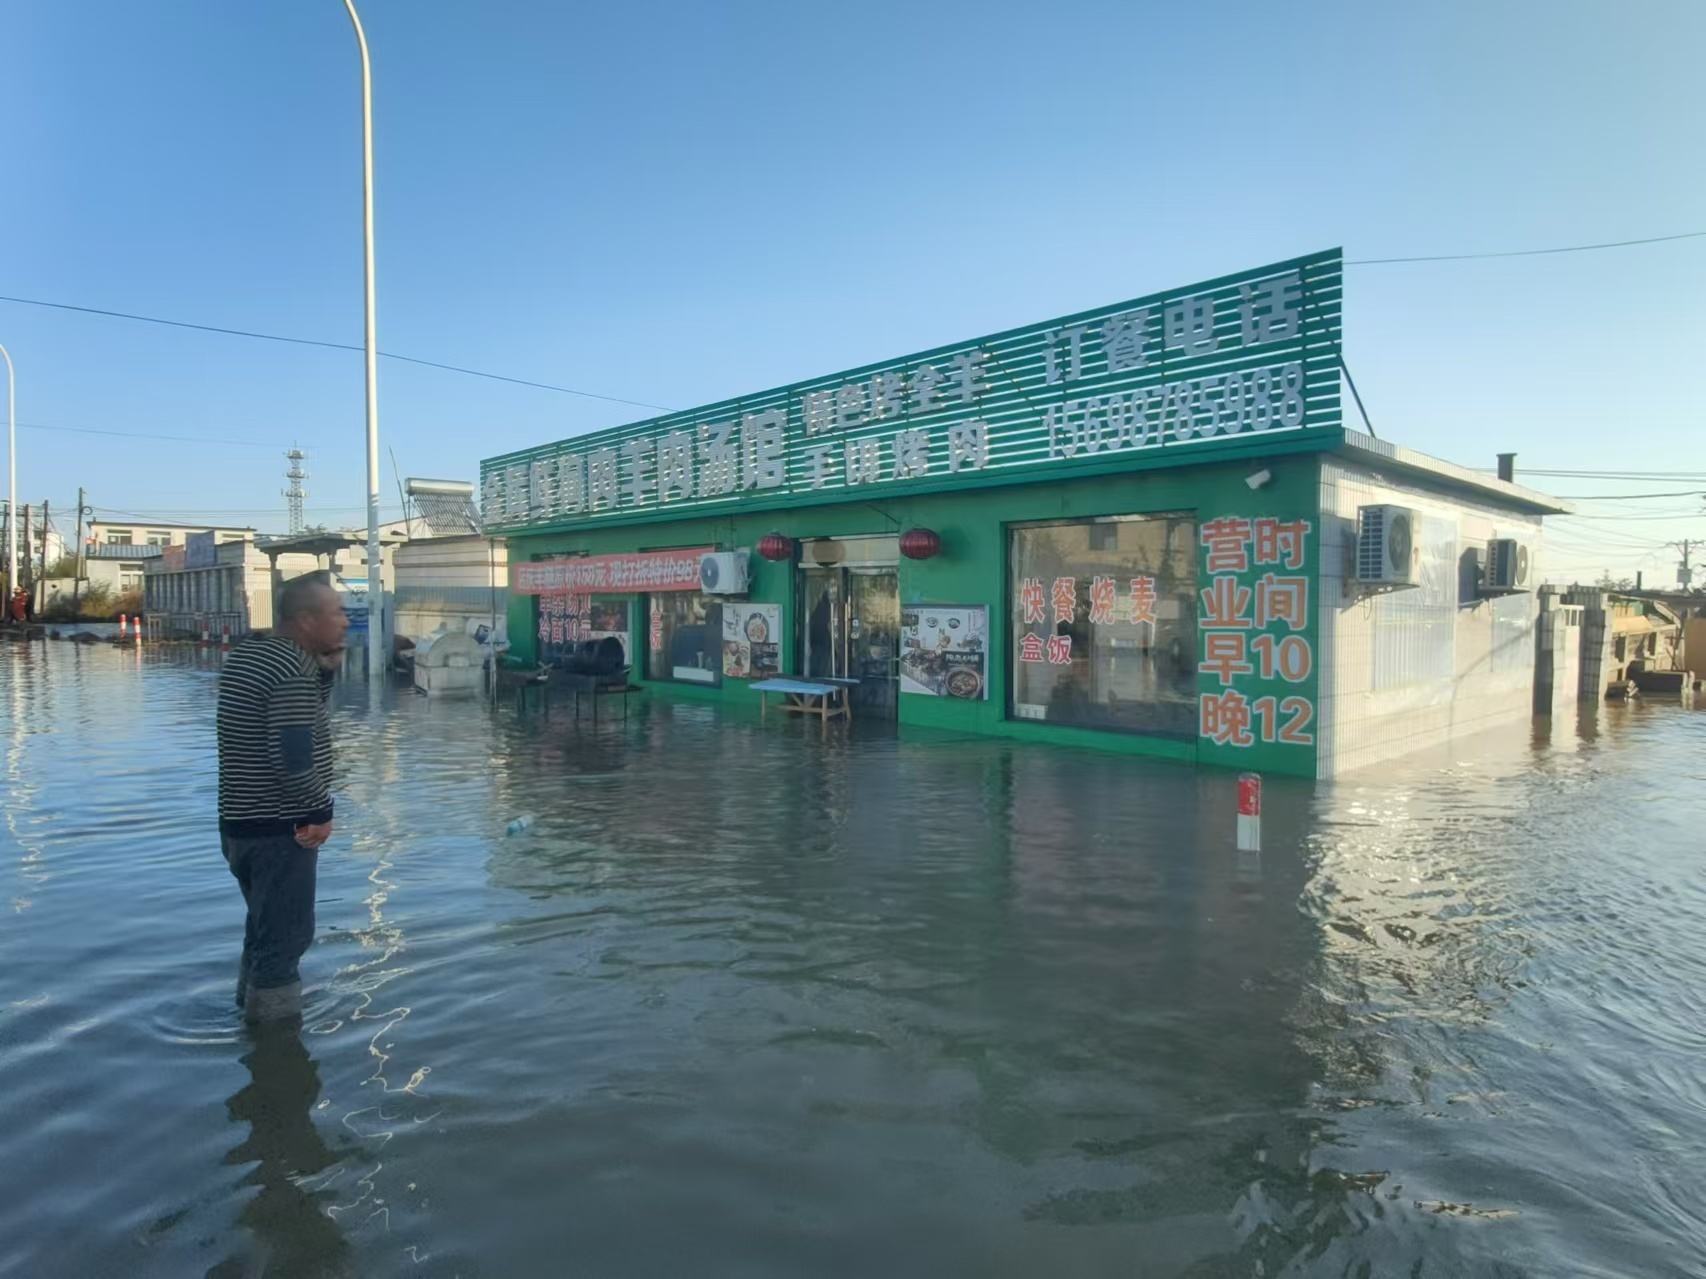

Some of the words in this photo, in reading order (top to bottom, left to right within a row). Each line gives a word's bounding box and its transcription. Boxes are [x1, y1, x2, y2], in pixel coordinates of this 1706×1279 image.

[1042, 273, 1303, 386] 订餐电话
[801, 350, 987, 437] 特色烤全羊
[1042, 362, 1304, 457] 15698785988
[1020, 575, 1158, 625] 快餐烧麦
[1199, 516, 1252, 630] 营业
[1253, 517, 1311, 631] 时间
[1020, 633, 1073, 665] 盒饭
[1199, 632, 1312, 686] 早10
[1199, 689, 1314, 748] 晚12
